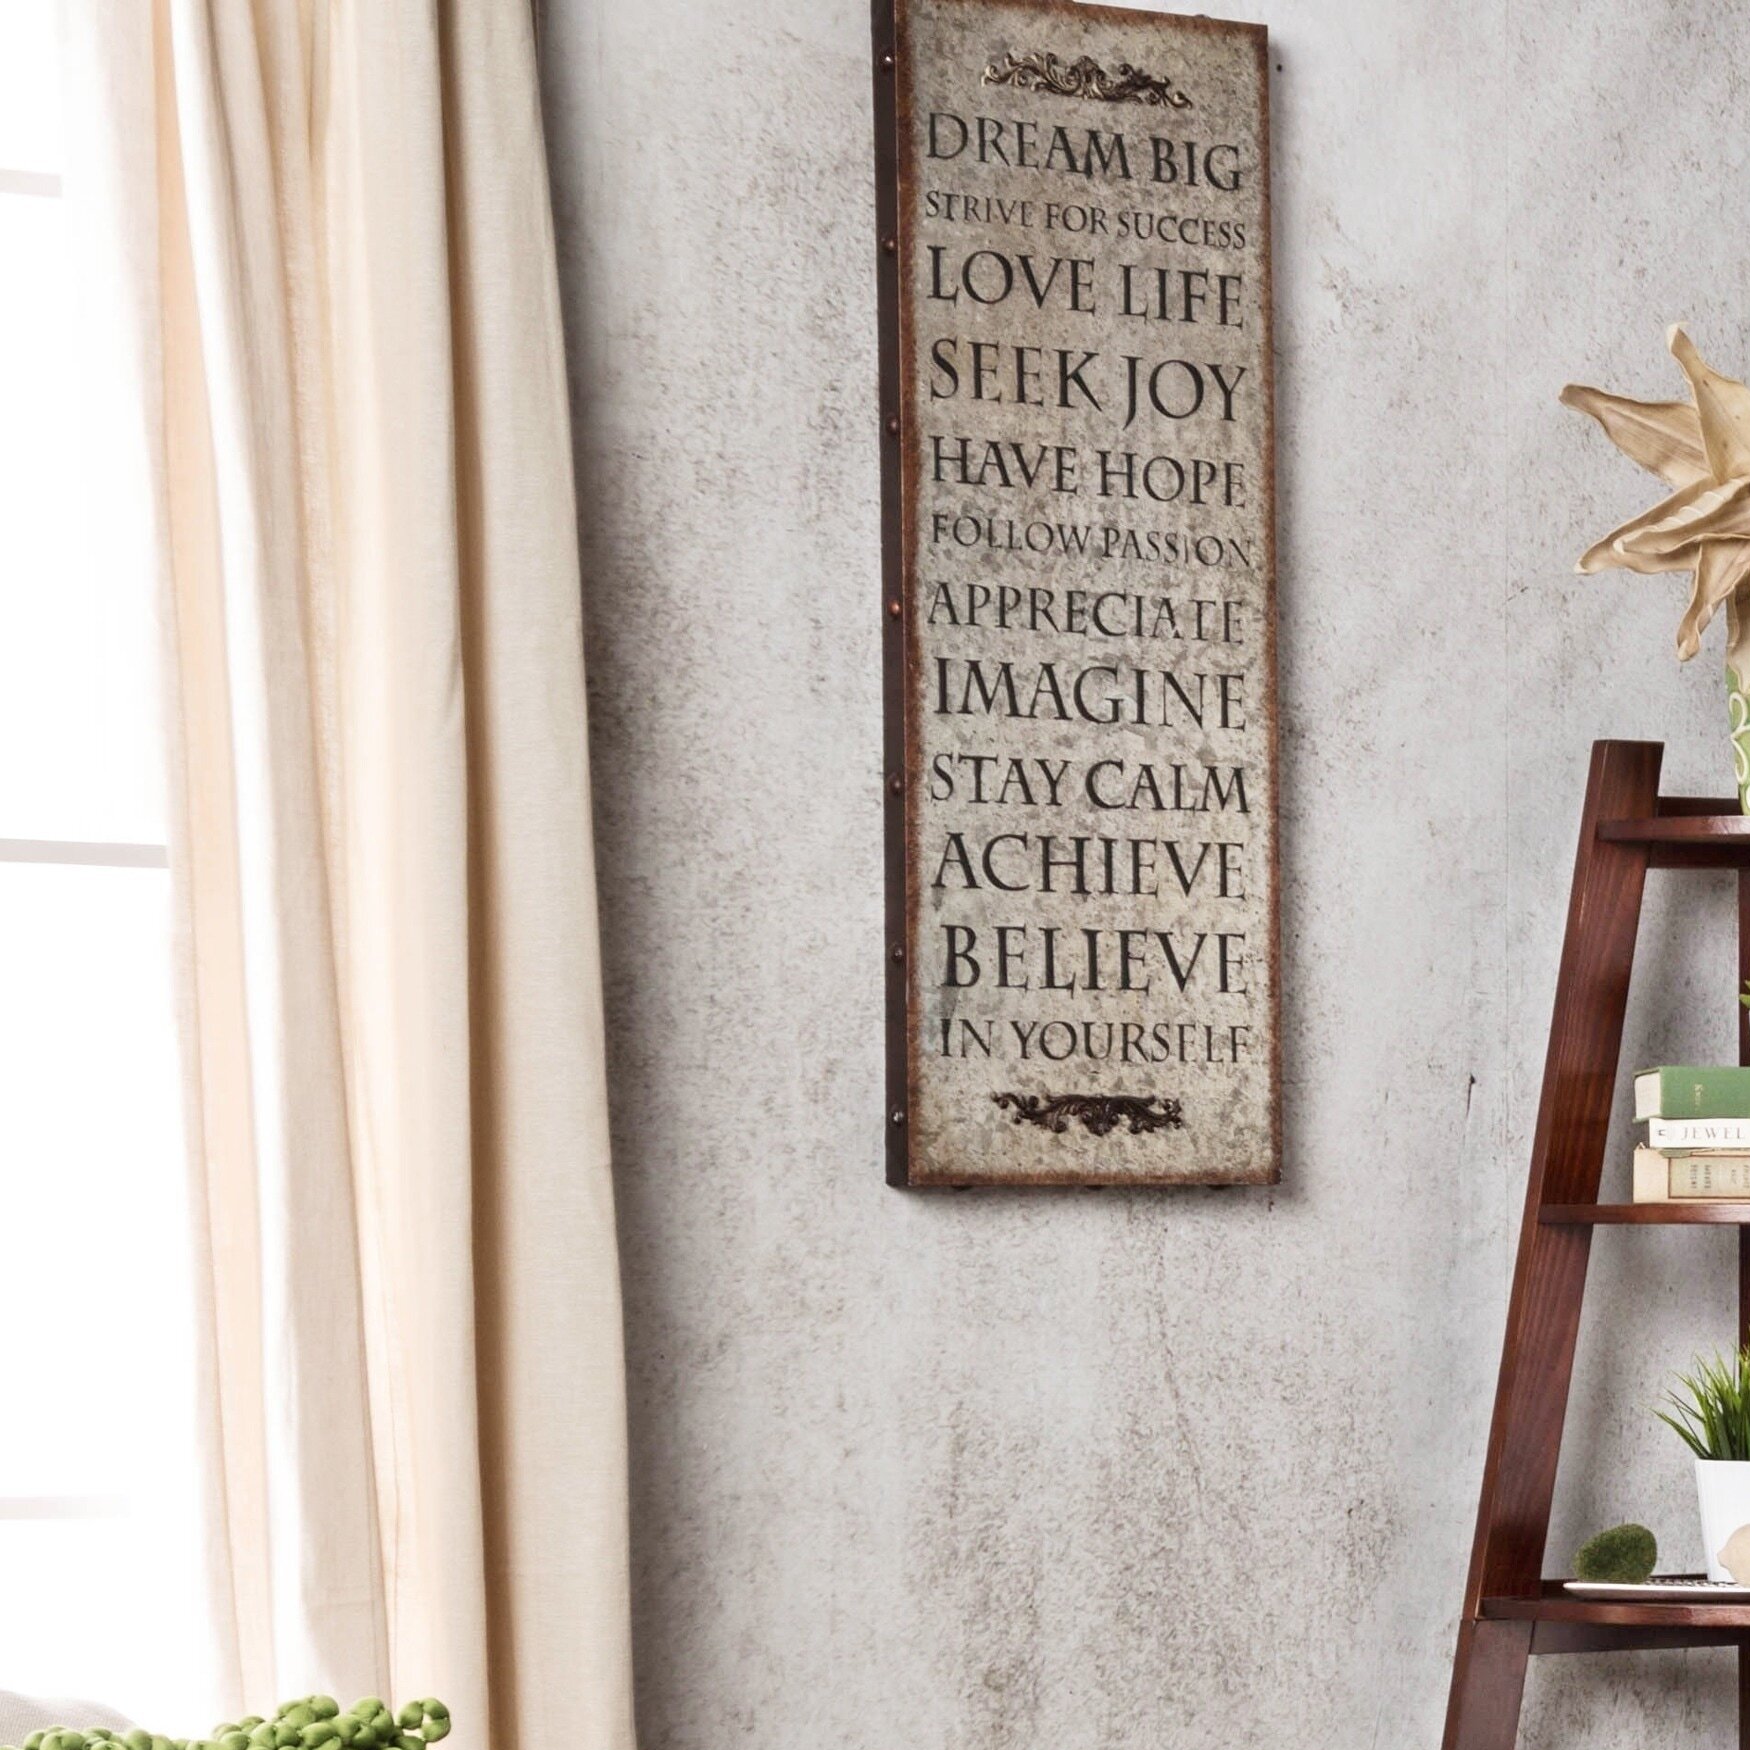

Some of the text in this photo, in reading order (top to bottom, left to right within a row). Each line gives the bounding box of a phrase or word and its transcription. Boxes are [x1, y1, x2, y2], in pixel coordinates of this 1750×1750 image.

[927, 112, 1242, 191] DREAM BIG
[926, 191, 1246, 249] STRIVE FOR SUCCESS
[927, 246, 1244, 328] LOVE LIFE
[930, 338, 1248, 430] SEEK JOY
[930, 435, 1246, 508] HAVE HOPE
[933, 514, 1251, 568] FOLLOW PASSION
[927, 581, 1245, 644] APPRECIATE
[934, 657, 1247, 732] IMAGINE
[930, 753, 1250, 813] STAY CALM
[931, 832, 1246, 900] ACHIEVE
[941, 924, 1247, 995] BELIEVE
[940, 1018, 1249, 1064] IN YOURSELF
[1681, 1127, 1745, 1141] JEWEL
